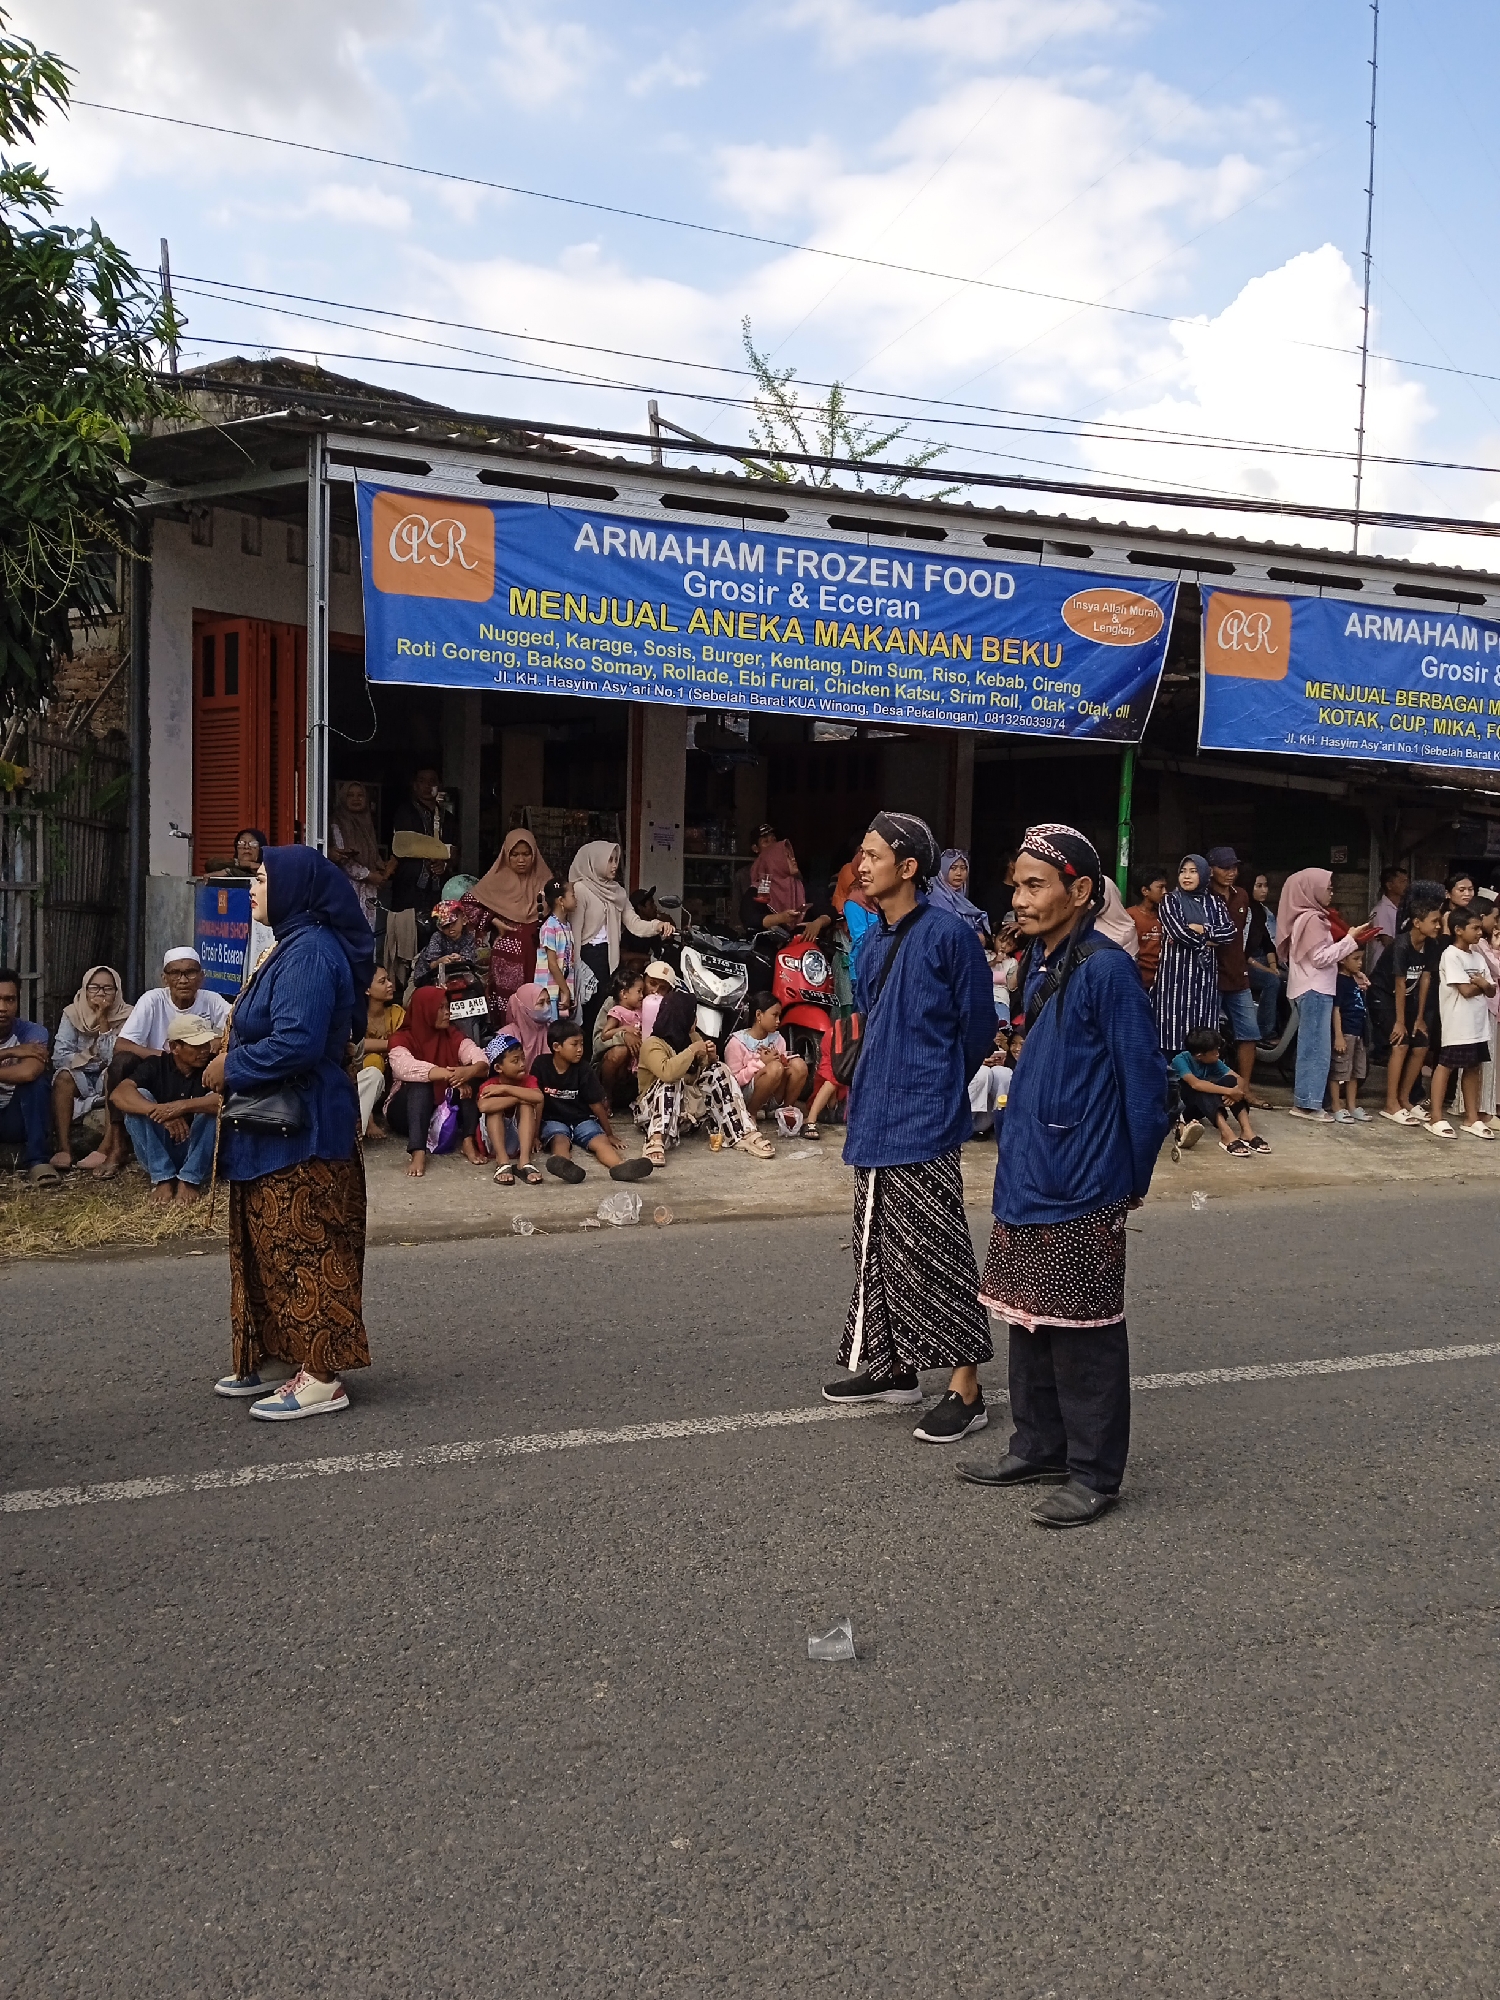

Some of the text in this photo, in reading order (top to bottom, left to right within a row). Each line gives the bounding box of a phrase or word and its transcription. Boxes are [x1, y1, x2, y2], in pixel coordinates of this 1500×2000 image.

[573, 522, 1017, 600] ARMAHAM FROZEN FOOD
[683, 571, 921, 620] Grosir & Eceran
[1073, 598, 1159, 619] Insya Allah Murah
[509, 587, 1063, 668] MENJUAL ANEKA MAKANAN BEKU
[1093, 621, 1135, 638] Lengkap
[1111, 614, 1120, 624] &
[1344, 611, 1479, 652] ARMAHAM
[478, 623, 1082, 698] Nugged, Karage, Sosis, Burger, Kentang, Dim Sum, Riso, Kebab, Cireng
[1421, 655, 1489, 684] Grosir
[396, 638, 436, 658] Roti
[442, 642, 521, 668] Goreng,
[527, 650, 586, 672] Bakso
[591, 656, 657, 681] Somay,
[662, 663, 733, 688] Rollade,
[739, 670, 766, 688] Ebi
[770, 672, 819, 695] Furai,
[824, 677, 890, 699] Chicken
[895, 683, 945, 706] Katsu,
[949, 688, 985, 707] Srim
[990, 691, 1023, 711] Roll,
[1030, 695, 1066, 714] Otak
[1077, 700, 1113, 719] Otak,
[1115, 704, 1131, 719] dll
[493, 671, 511, 684] Jl.
[515, 672, 541, 686] KH.
[546, 676, 598, 693] Hasyim
[654, 684, 684, 699] No.1
[688, 688, 746, 704] (Sebelah
[750, 693, 785, 707] Barat
[788, 696, 817, 710] KUA
[819, 698, 870, 716] Winong,
[873, 703, 903, 716] Desa
[1305, 680, 1391, 705] MENJUAL
[1395, 689, 1483, 714] BERBAGAI
[1318, 707, 1384, 732] KOTAK,
[1389, 713, 1428, 736] CUP,
[1432, 718, 1481, 741] MIKA,
[1299, 734, 1318, 745] KH.
[1320, 736, 1358, 750] Hasyim
[1398, 742, 1418, 754] No.1
[1421, 744, 1463, 758] (Sebelah
[1465, 748, 1491, 760] Barat
[230, 921, 249, 940] SHOP
[201, 941, 219, 962] Grosir
[223, 944, 244, 965] Eceran
